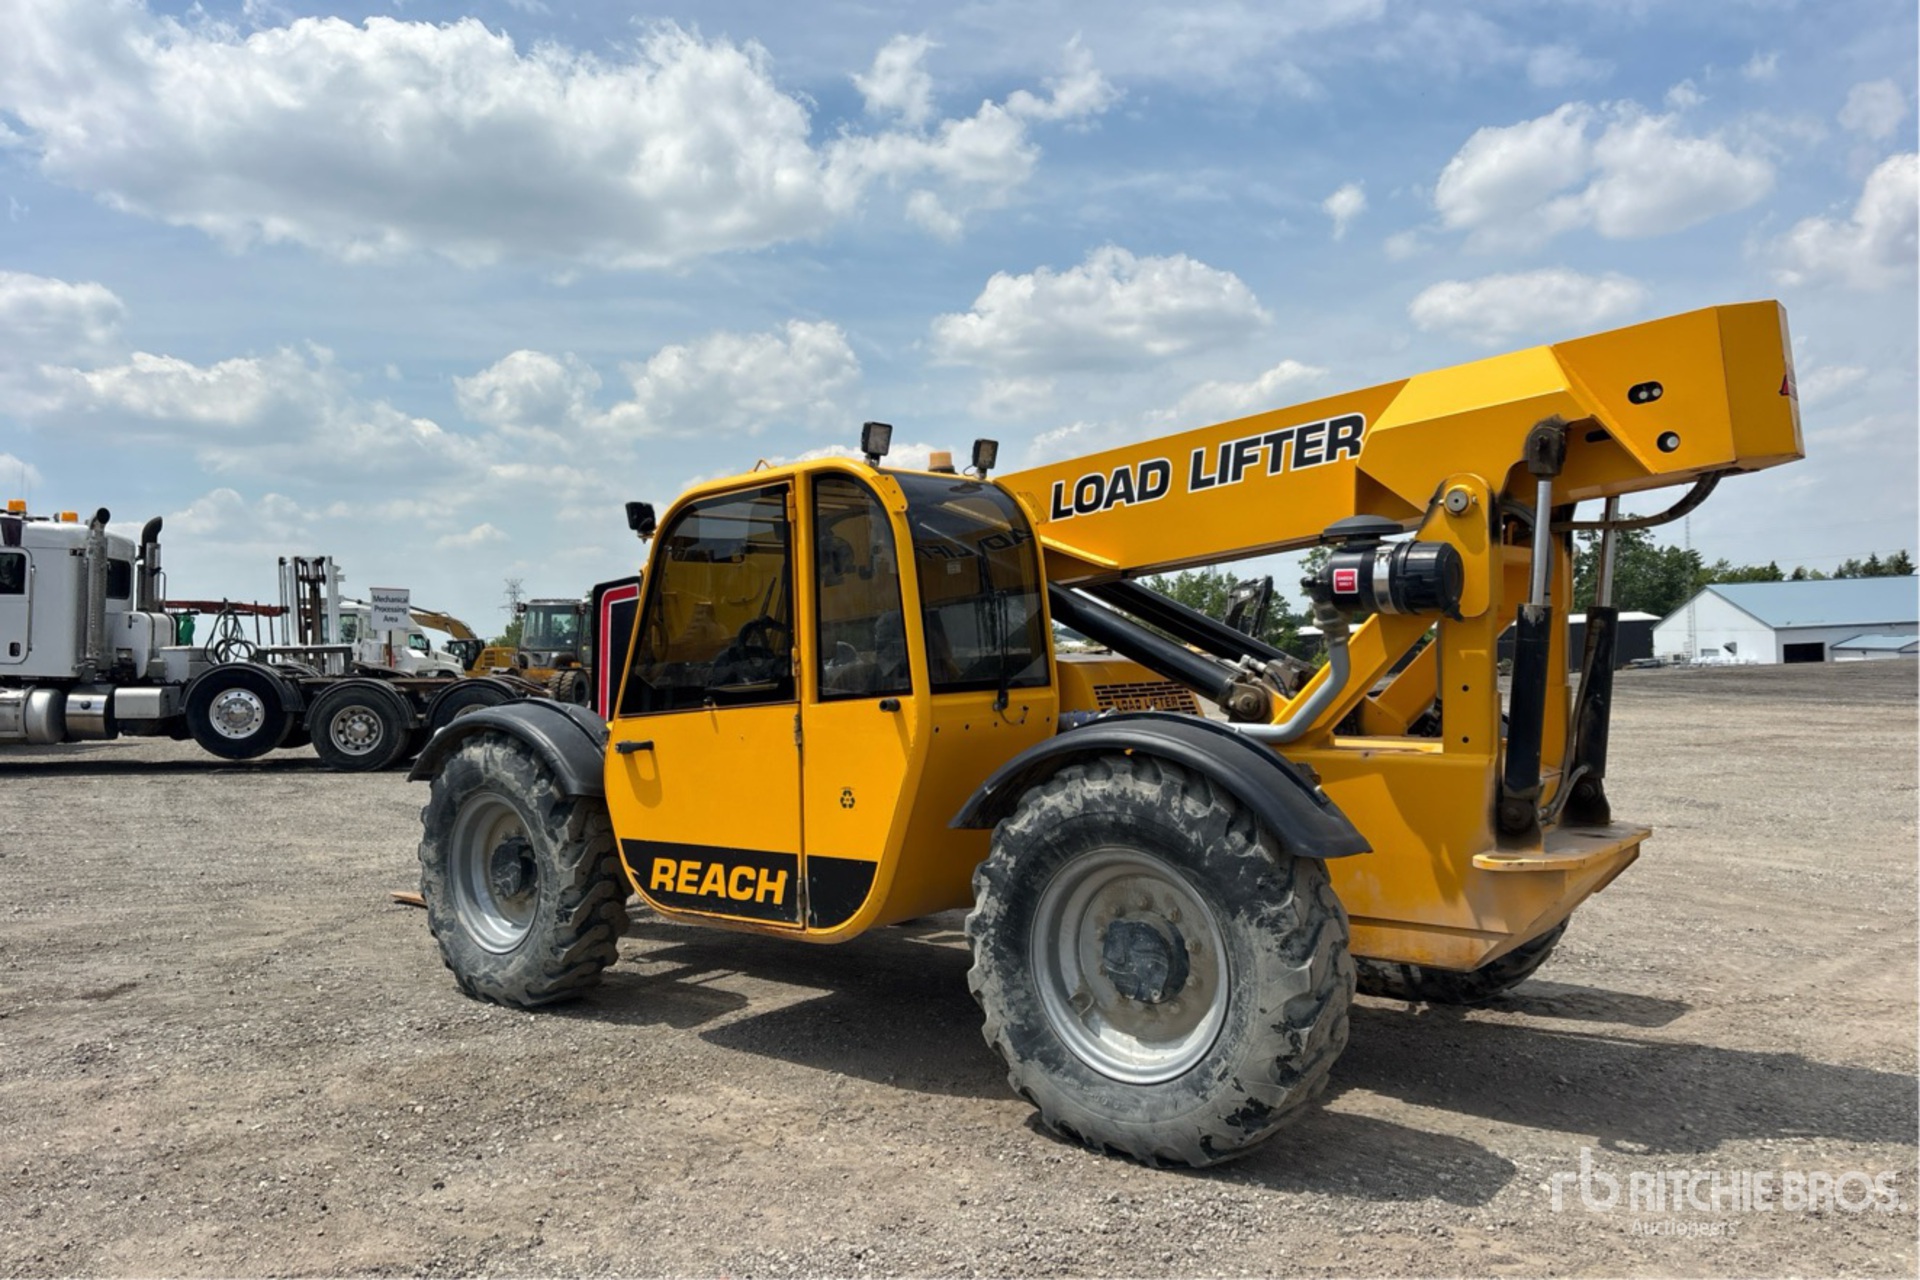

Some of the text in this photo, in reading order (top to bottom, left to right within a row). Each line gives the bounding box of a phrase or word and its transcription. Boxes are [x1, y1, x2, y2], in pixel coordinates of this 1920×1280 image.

[1050, 412, 1366, 522] LOAD LIFTER
[373, 595, 409, 604] Mechanical
[374, 605, 407, 614] Processing
[1116, 696, 1178, 711] LOAD LIFTER
[650, 857, 788, 905] REACH
